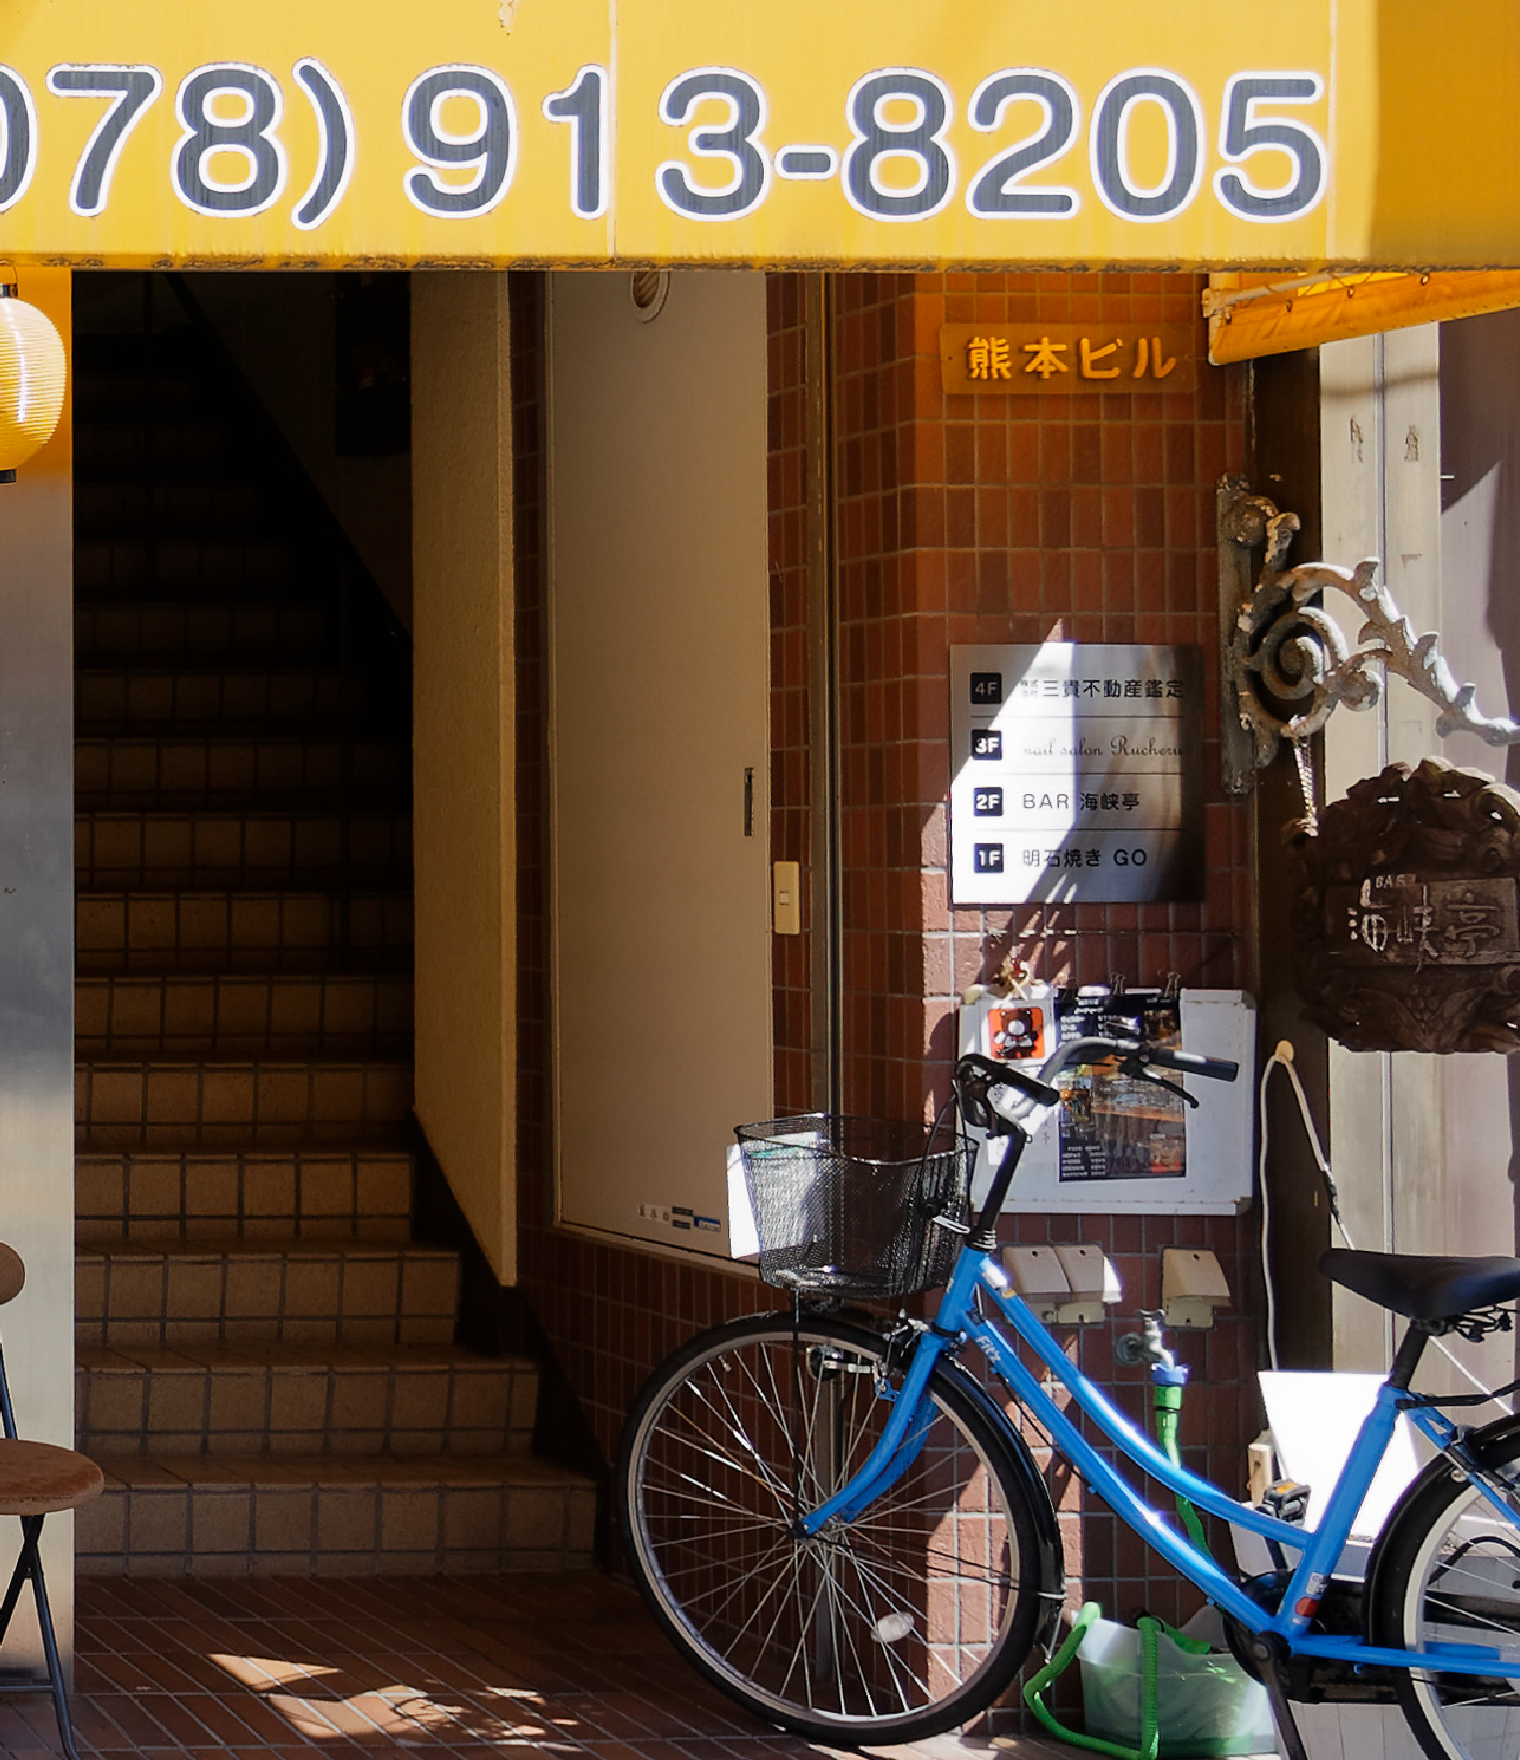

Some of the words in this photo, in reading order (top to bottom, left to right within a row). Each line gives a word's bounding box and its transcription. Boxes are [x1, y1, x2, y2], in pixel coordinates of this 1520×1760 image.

[966, 336, 1176, 381] 熊本ビル
[974, 681, 998, 696] 4F
[975, 737, 999, 755] 3F
[975, 794, 1001, 810] 2F
[1023, 793, 1070, 809] BAR
[1079, 792, 1140, 811] 海峡亭
[978, 851, 1001, 866] 1F
[1022, 848, 1101, 868] 明石焼き
[1112, 848, 1148, 867] GO
